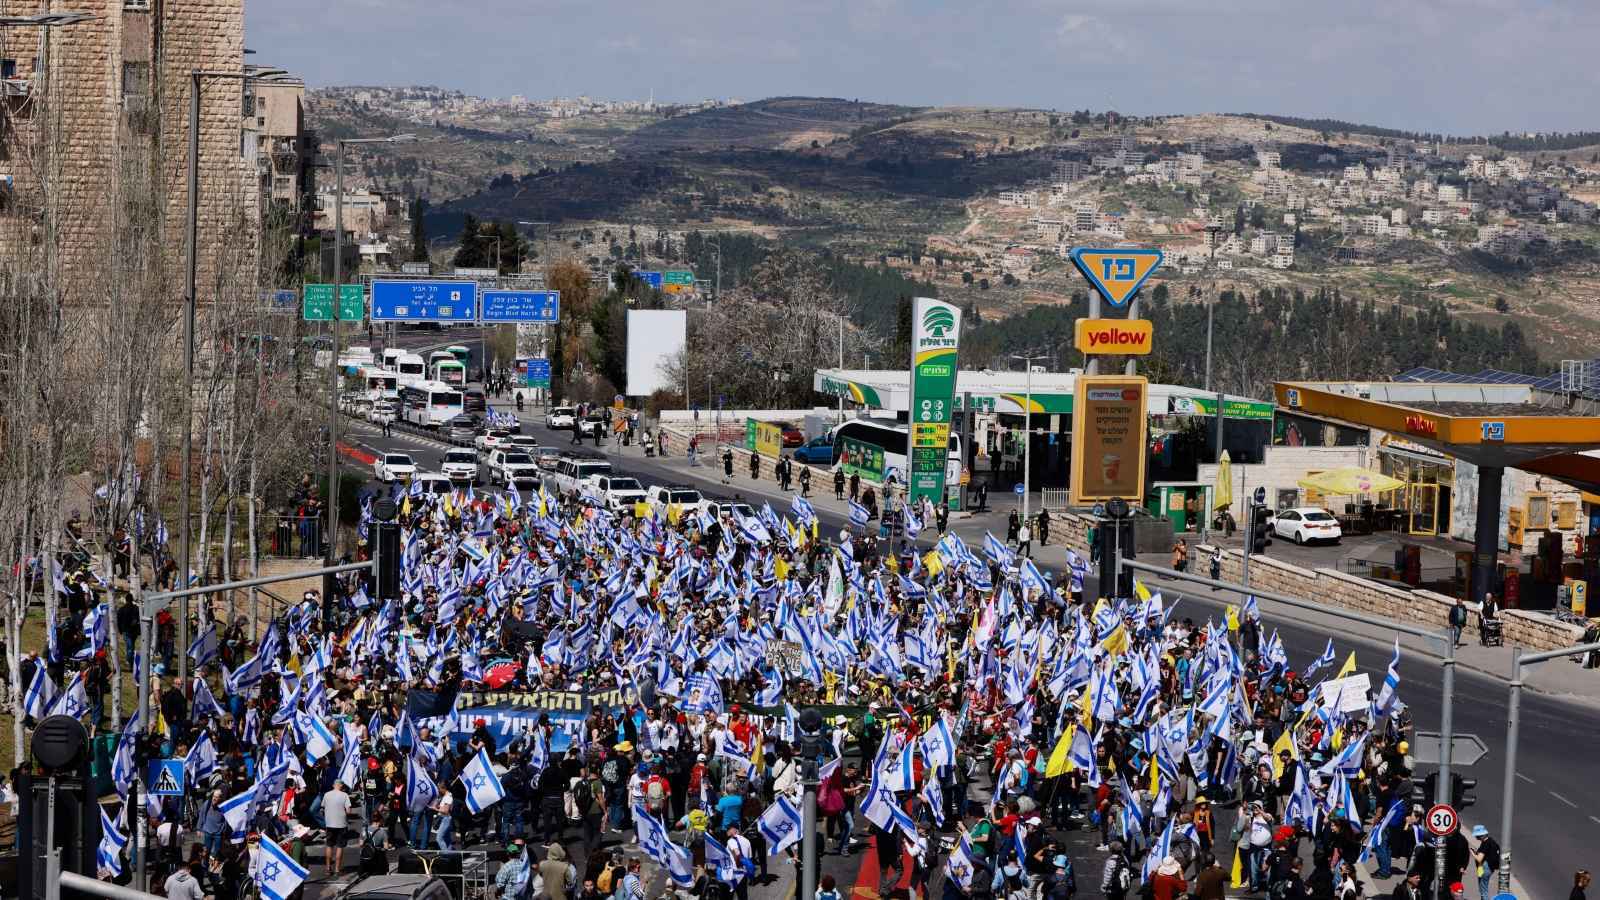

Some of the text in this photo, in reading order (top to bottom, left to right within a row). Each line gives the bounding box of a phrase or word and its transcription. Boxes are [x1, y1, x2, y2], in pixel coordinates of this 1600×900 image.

[1102, 258, 1136, 280] פז
[1088, 328, 1146, 347] yellow
[767, 640, 785, 652] WE
[1433, 814, 1451, 827] 30
